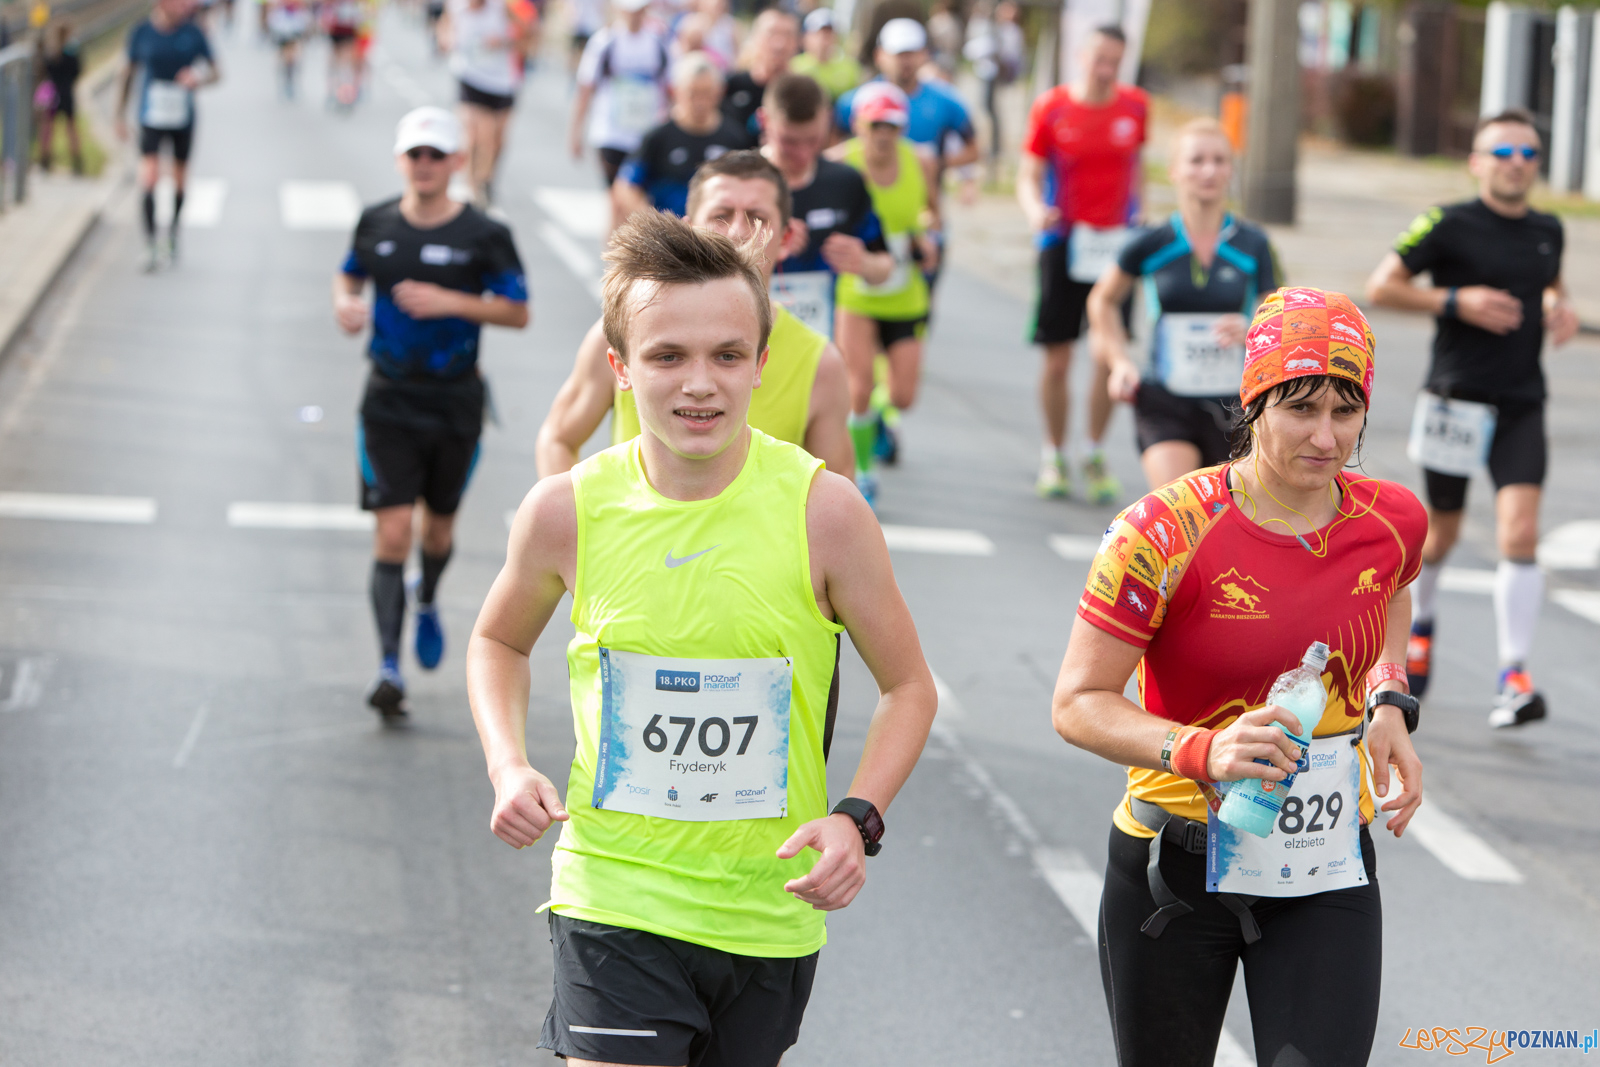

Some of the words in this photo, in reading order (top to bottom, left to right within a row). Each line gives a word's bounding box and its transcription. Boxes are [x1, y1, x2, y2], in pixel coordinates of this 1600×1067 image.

[1352, 583, 1381, 595] ATTIQ
[660, 676, 673, 685] 18.
[674, 676, 697, 687] PKO
[642, 714, 758, 757] 6707
[669, 760, 726, 774] Fryderyk
[1270, 791, 1343, 835] 829
[1284, 836, 1325, 849] elzbieta
